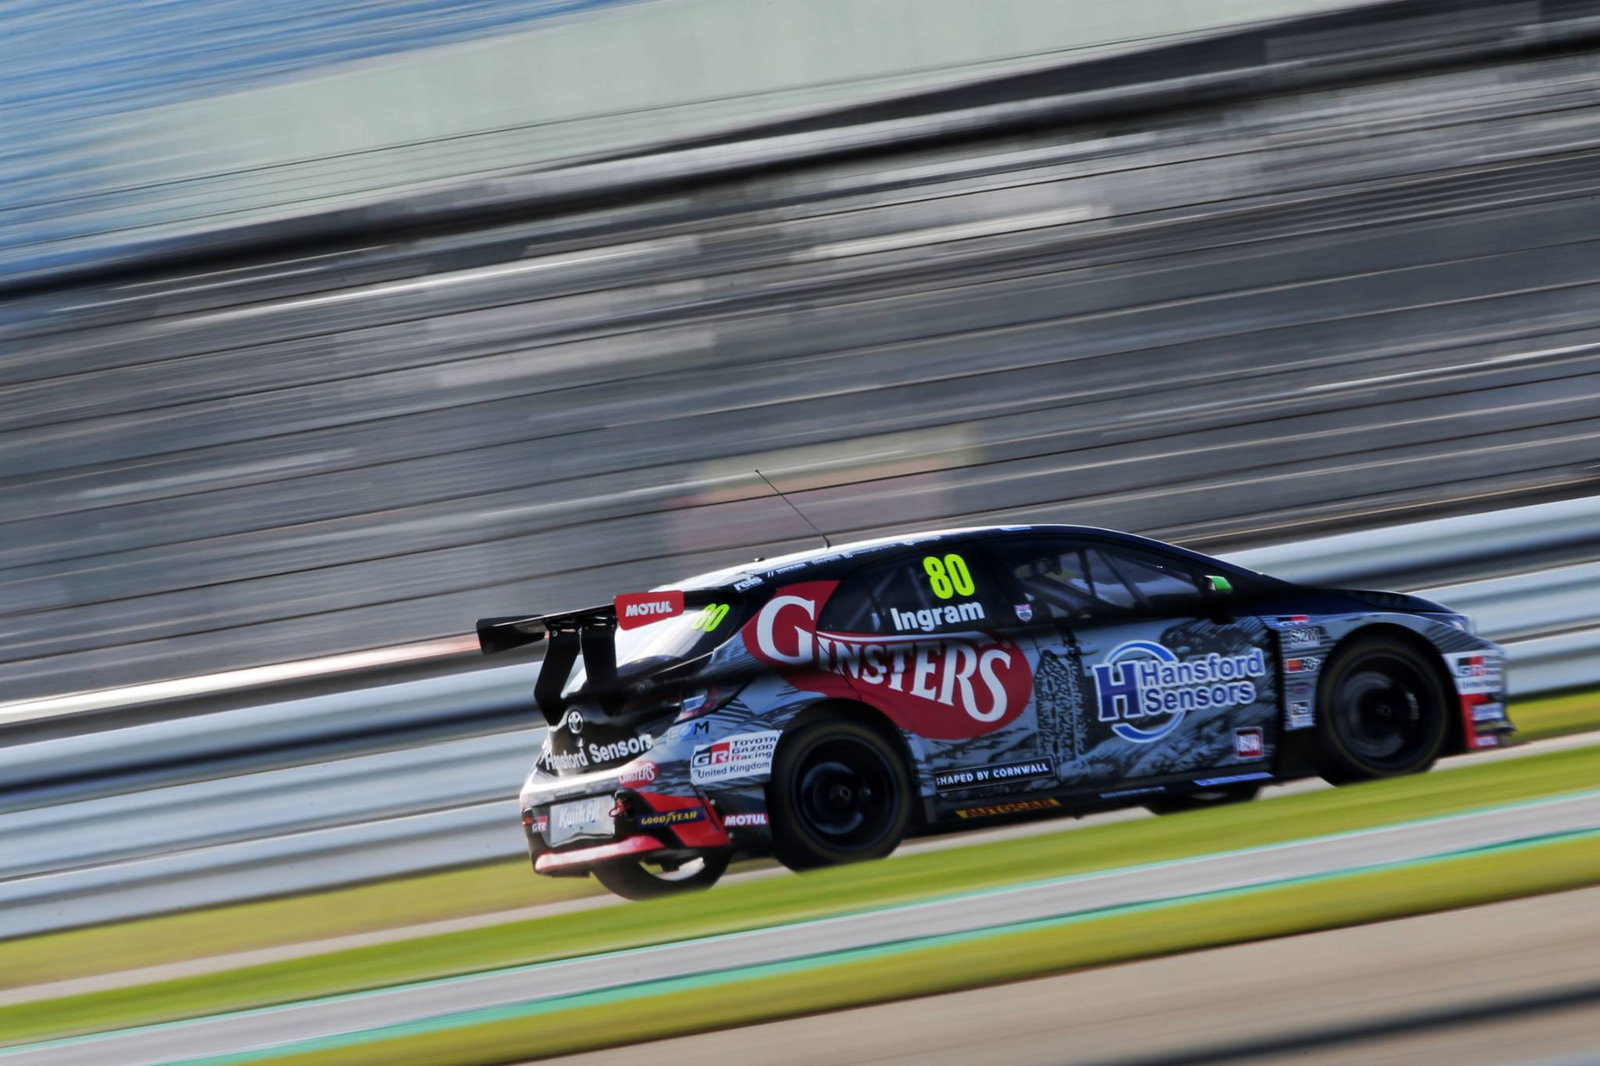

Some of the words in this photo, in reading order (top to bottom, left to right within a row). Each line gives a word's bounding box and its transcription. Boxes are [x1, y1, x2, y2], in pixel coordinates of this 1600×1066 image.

[922, 553, 976, 600] 80
[625, 601, 673, 617] MOTUL
[890, 601, 986, 632] Ingram
[756, 595, 1012, 722] GINSTERS
[1139, 648, 1266, 687] Hansford
[1143, 682, 1256, 715] Sensors
[589, 734, 653, 764] Sensors
[732, 736, 777, 747] TOYOTA
[732, 744, 774, 754] GAZOO
[693, 750, 730, 767] GR
[730, 751, 772, 762] Racing
[698, 768, 728, 779] United
[729, 761, 771, 775] Kingdom
[976, 771, 990, 780] BY
[993, 763, 1049, 778] CORNWALL
[641, 811, 697, 825] GOODYEAR
[724, 813, 767, 826] MOTUL
